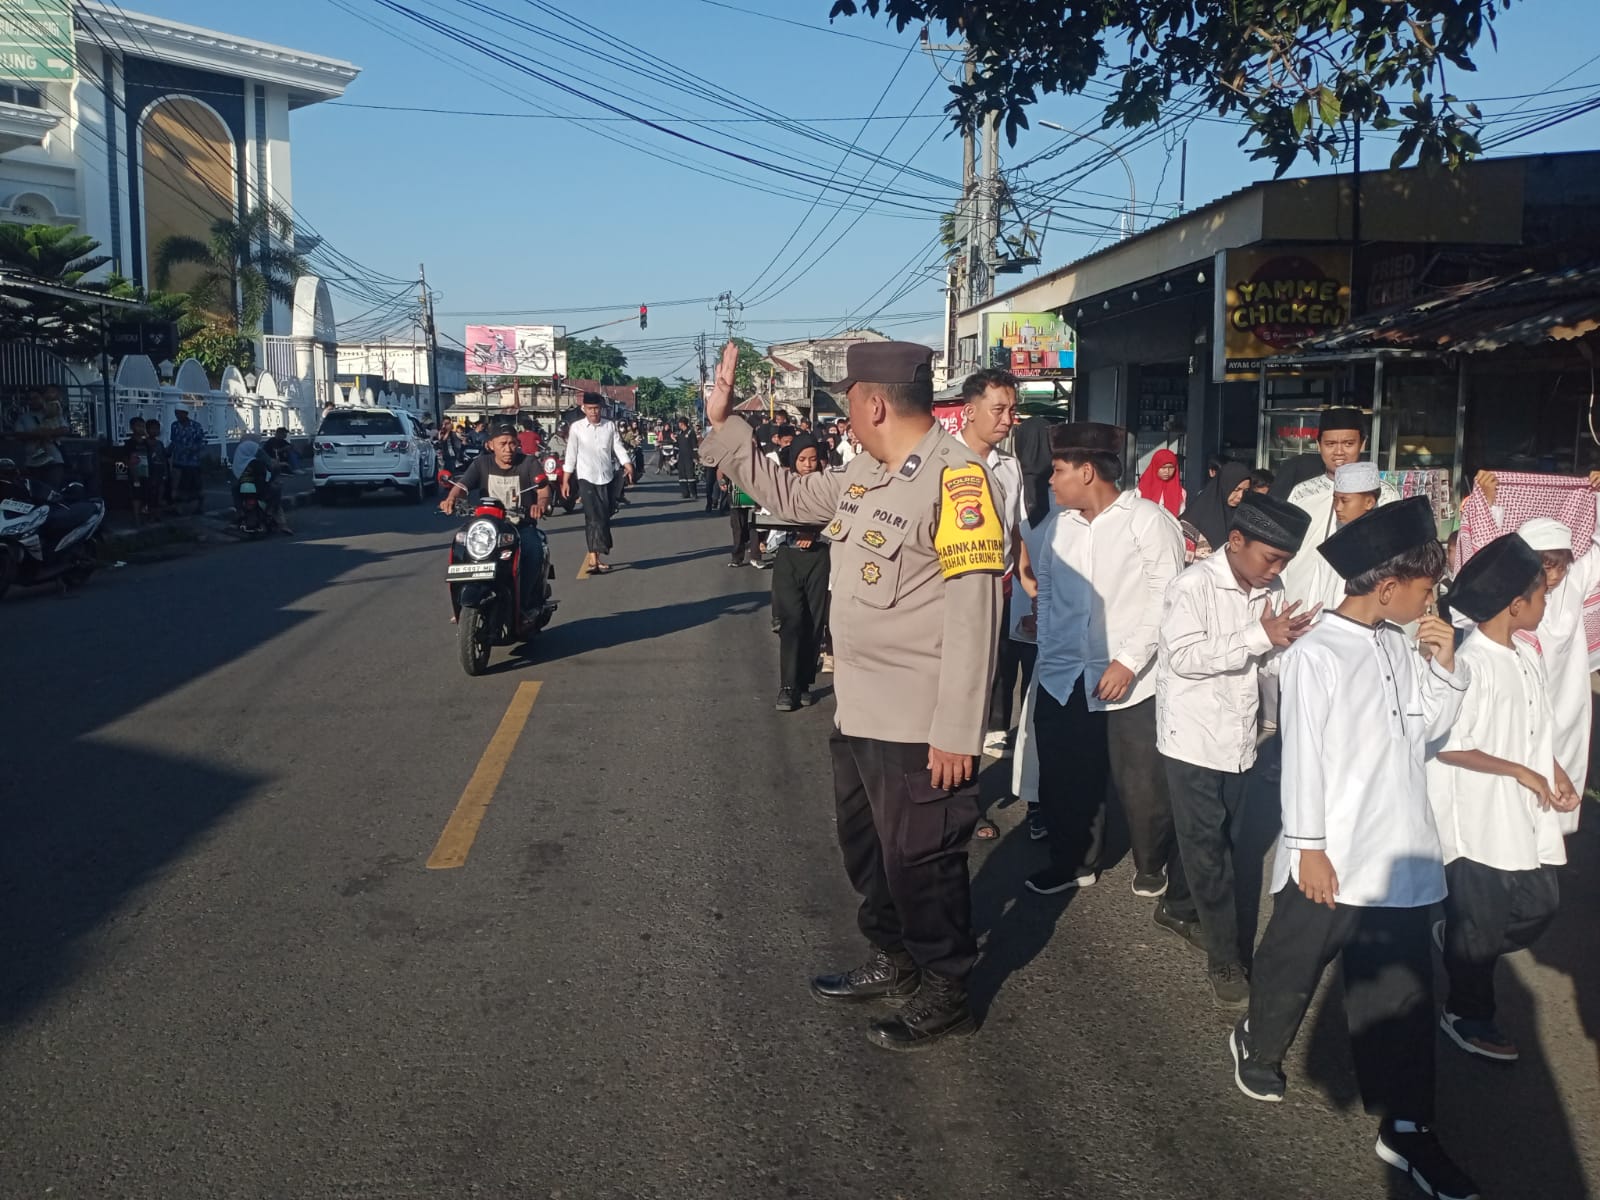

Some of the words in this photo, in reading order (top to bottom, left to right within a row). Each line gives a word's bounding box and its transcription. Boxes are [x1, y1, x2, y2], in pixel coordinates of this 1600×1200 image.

[1239, 279, 1337, 303] YAMME
[1233, 303, 1341, 328] CHICKEN
[873, 508, 908, 531] POLRI
[969, 550, 997, 565] GERUNG
